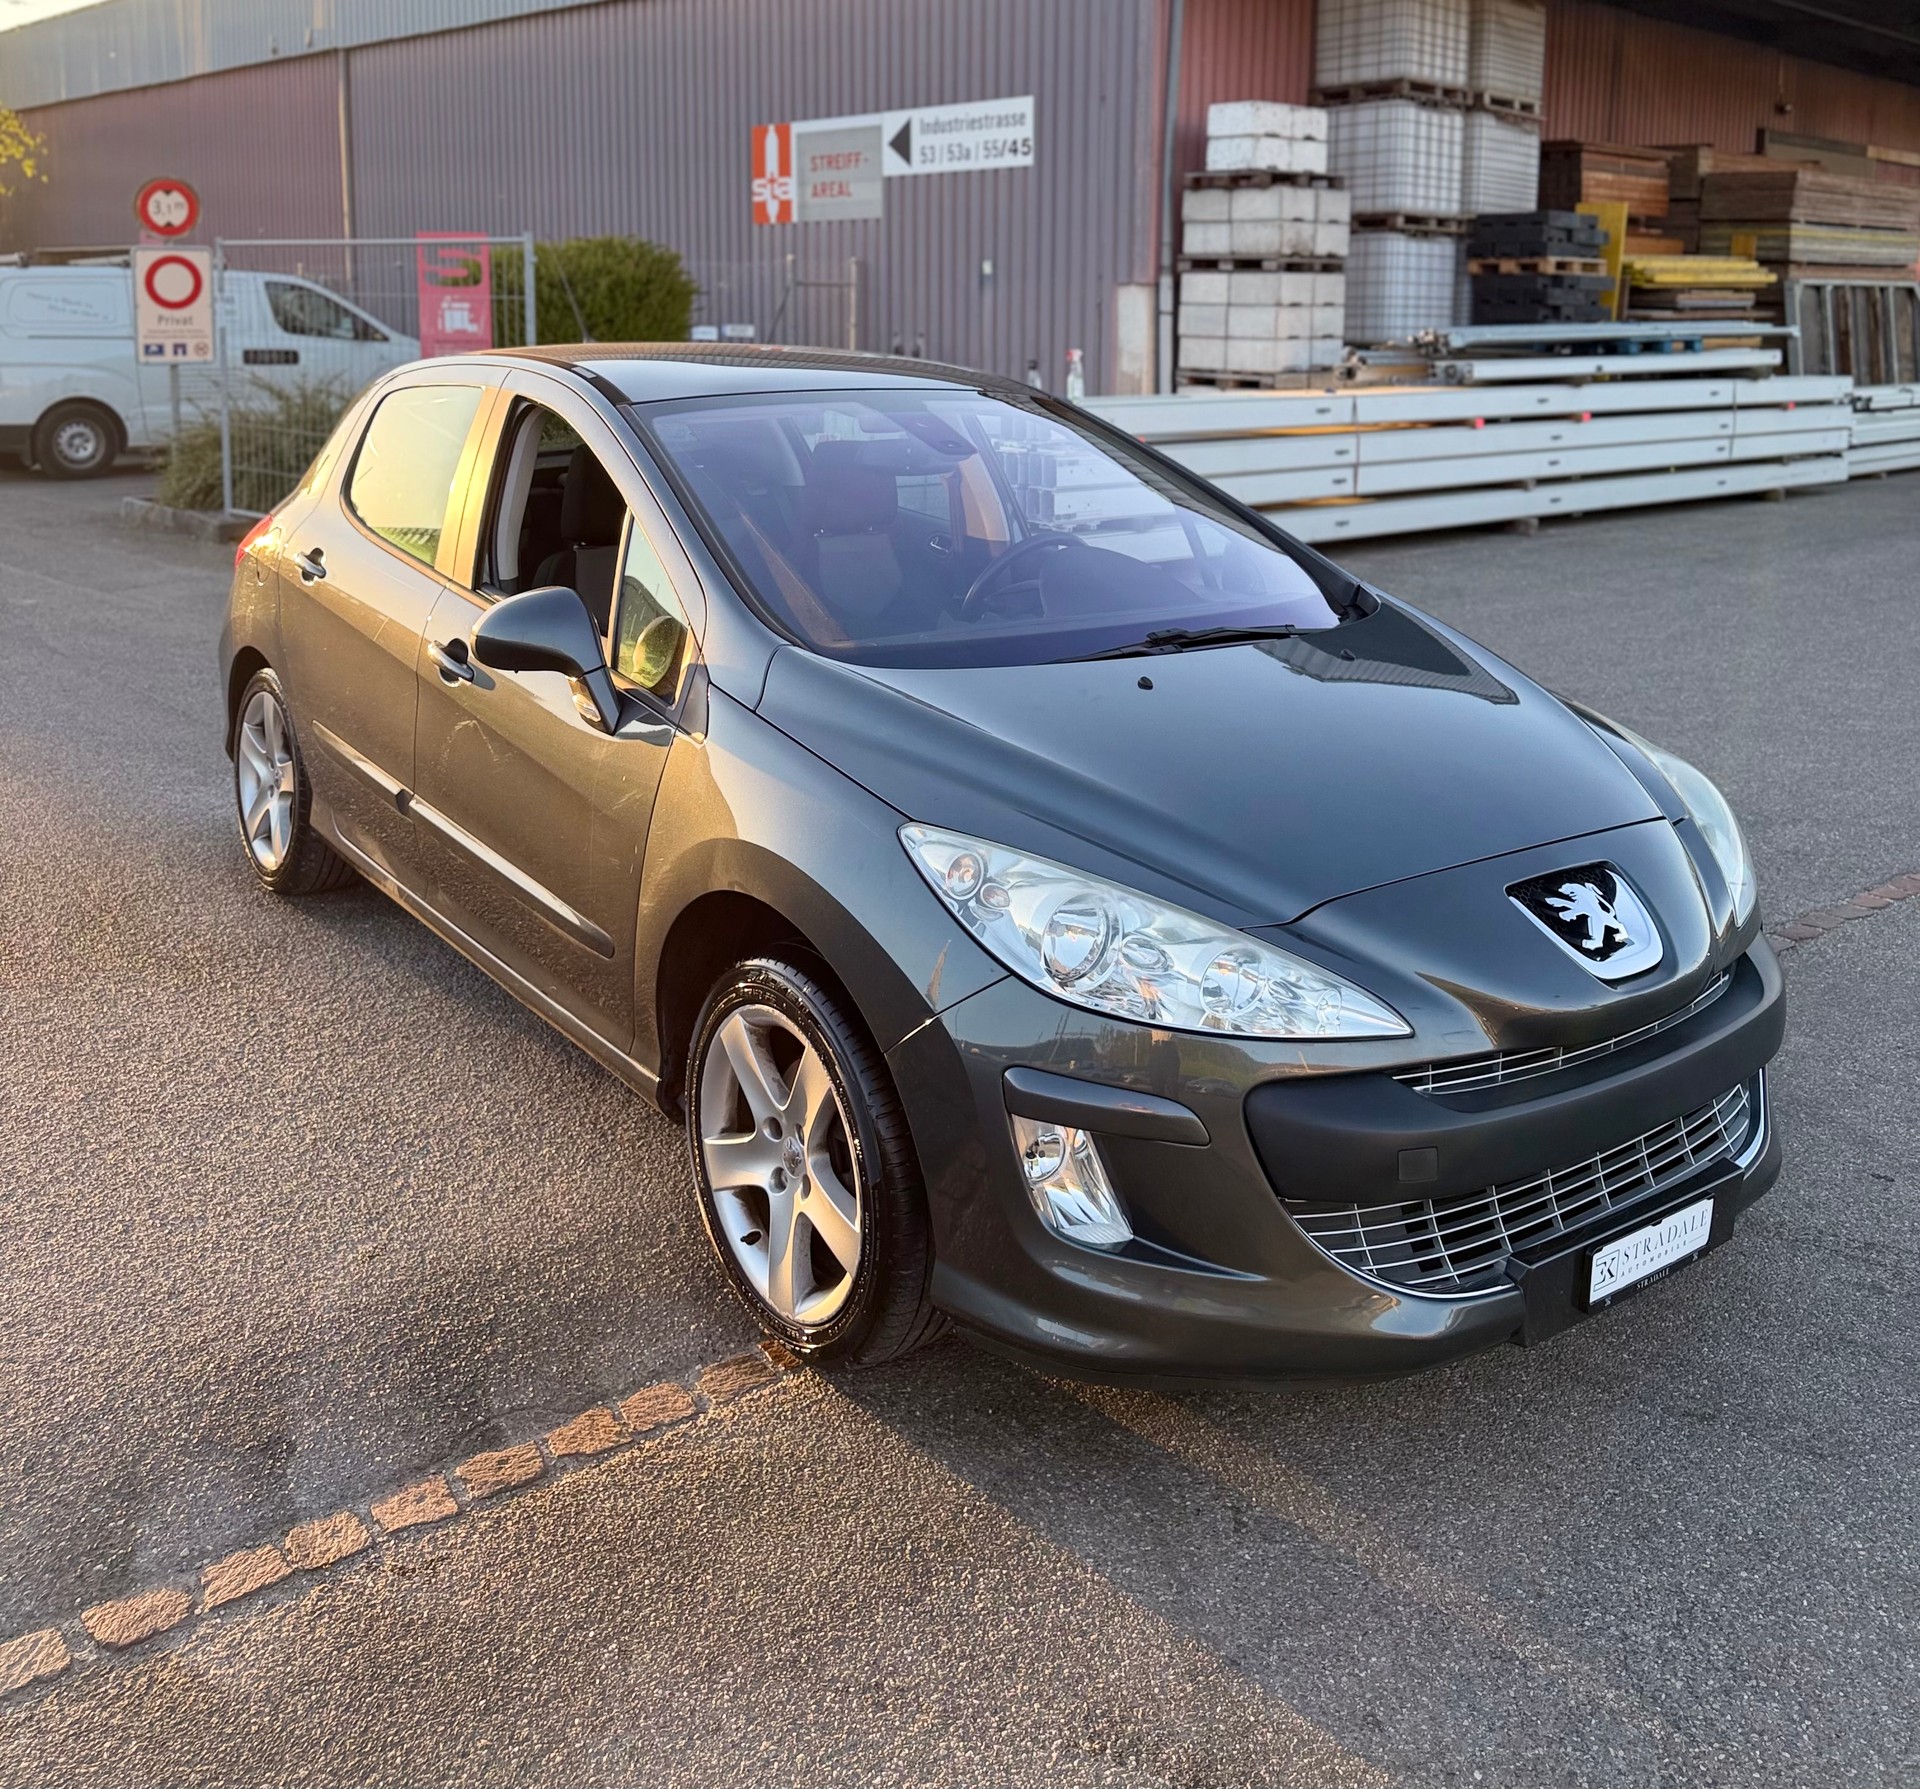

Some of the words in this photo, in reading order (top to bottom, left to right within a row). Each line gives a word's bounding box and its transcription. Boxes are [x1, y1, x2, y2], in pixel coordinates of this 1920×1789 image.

[920, 112, 1026, 135] Industriestrasse
[810, 150, 869, 173] STREIFF-
[920, 145, 936, 164] 53
[947, 142, 971, 162] 53a
[811, 181, 853, 198] AREAL
[157, 314, 194, 326] Privat
[1621, 1208, 1709, 1266] STRADALE
[1621, 1240, 1688, 1278] AUTOMOBILE
[1636, 1267, 1670, 1290] STRADALE
